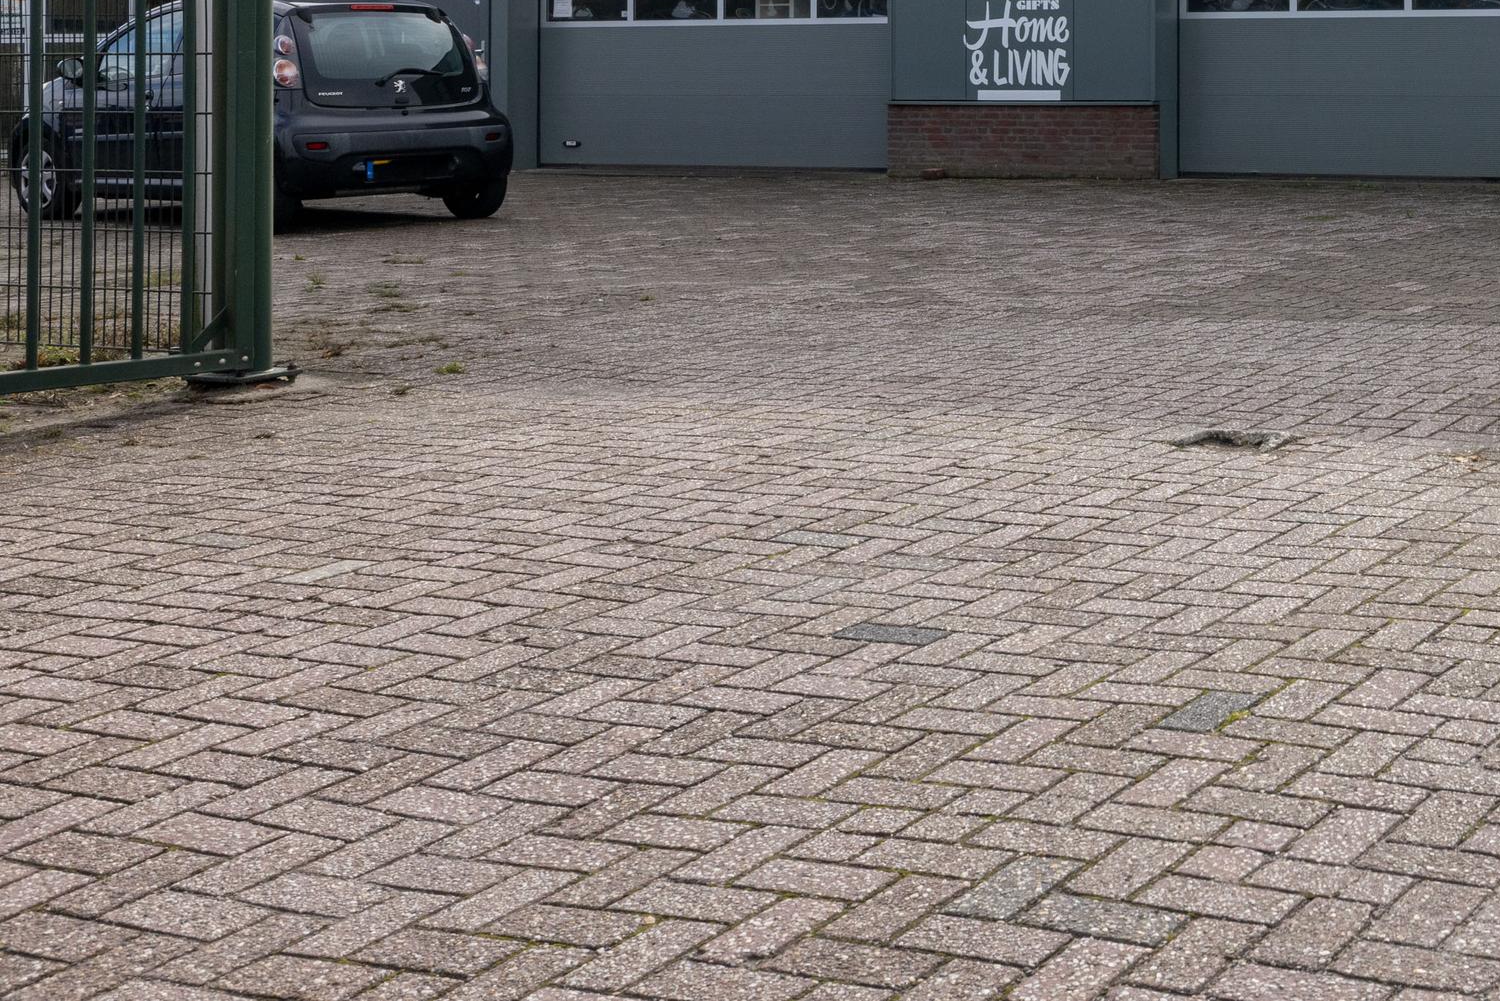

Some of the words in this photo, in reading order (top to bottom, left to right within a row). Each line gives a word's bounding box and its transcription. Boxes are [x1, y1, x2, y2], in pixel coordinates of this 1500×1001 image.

[1016, 0, 1060, 10] GIFTS
[963, 0, 1070, 50] Home
[969, 50, 989, 86] &
[993, 48, 1071, 86] LIVING
